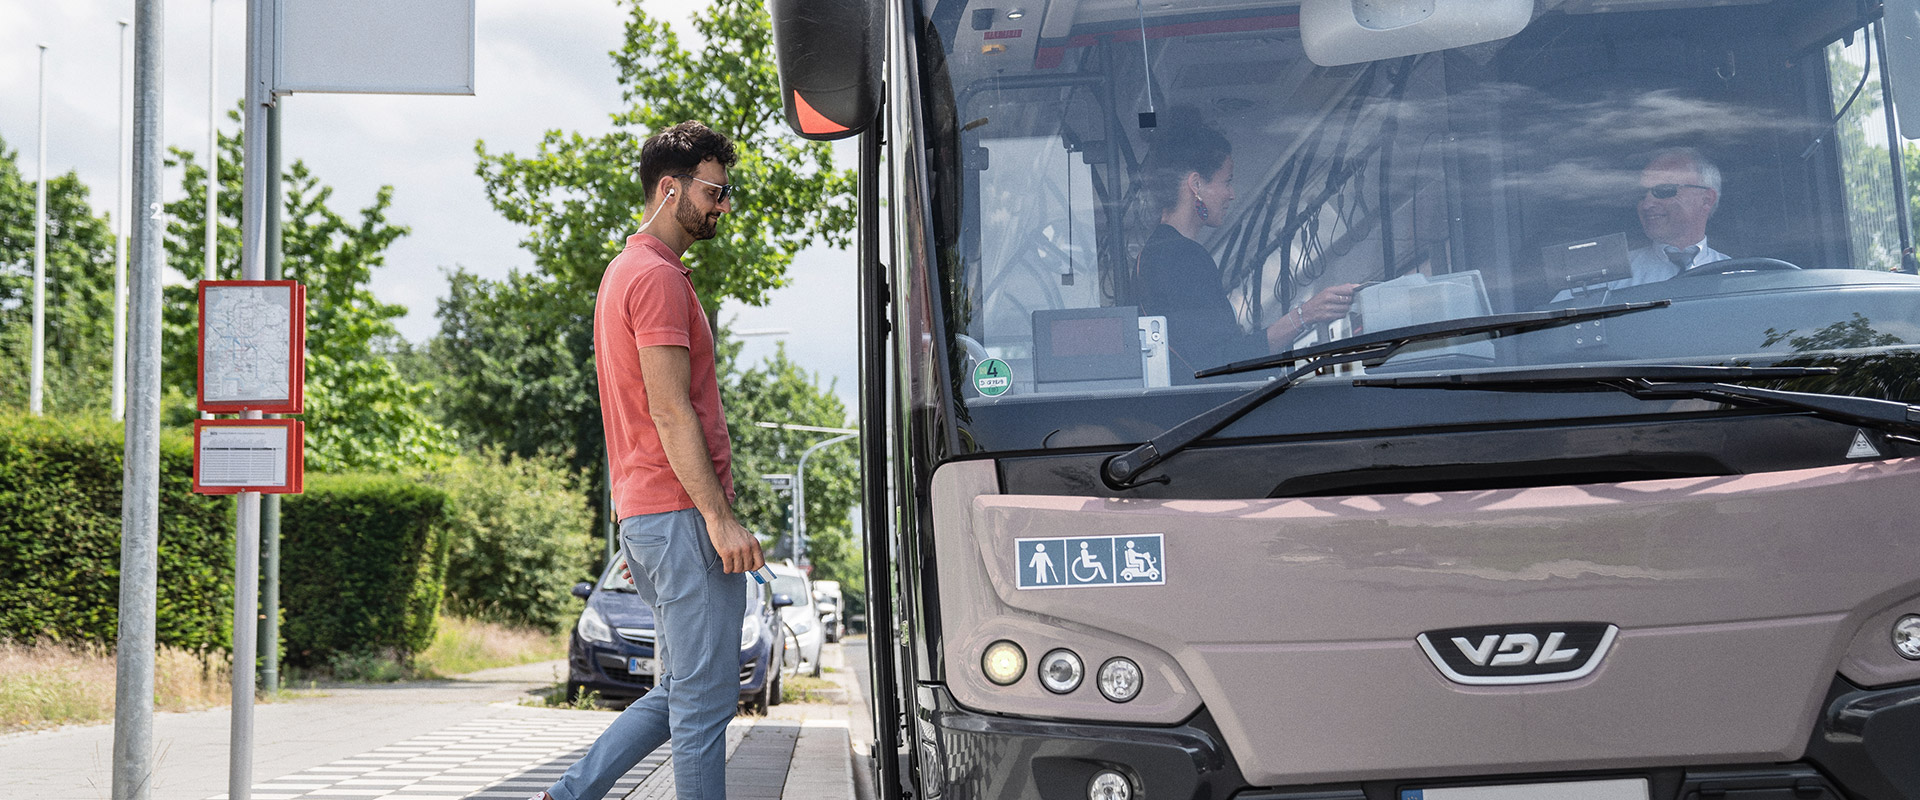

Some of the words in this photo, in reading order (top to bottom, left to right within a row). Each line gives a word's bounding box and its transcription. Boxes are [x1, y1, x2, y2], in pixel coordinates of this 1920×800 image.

[150, 202, 162, 220] 2
[987, 360, 998, 377] 4
[1450, 631, 1579, 667] VDL
